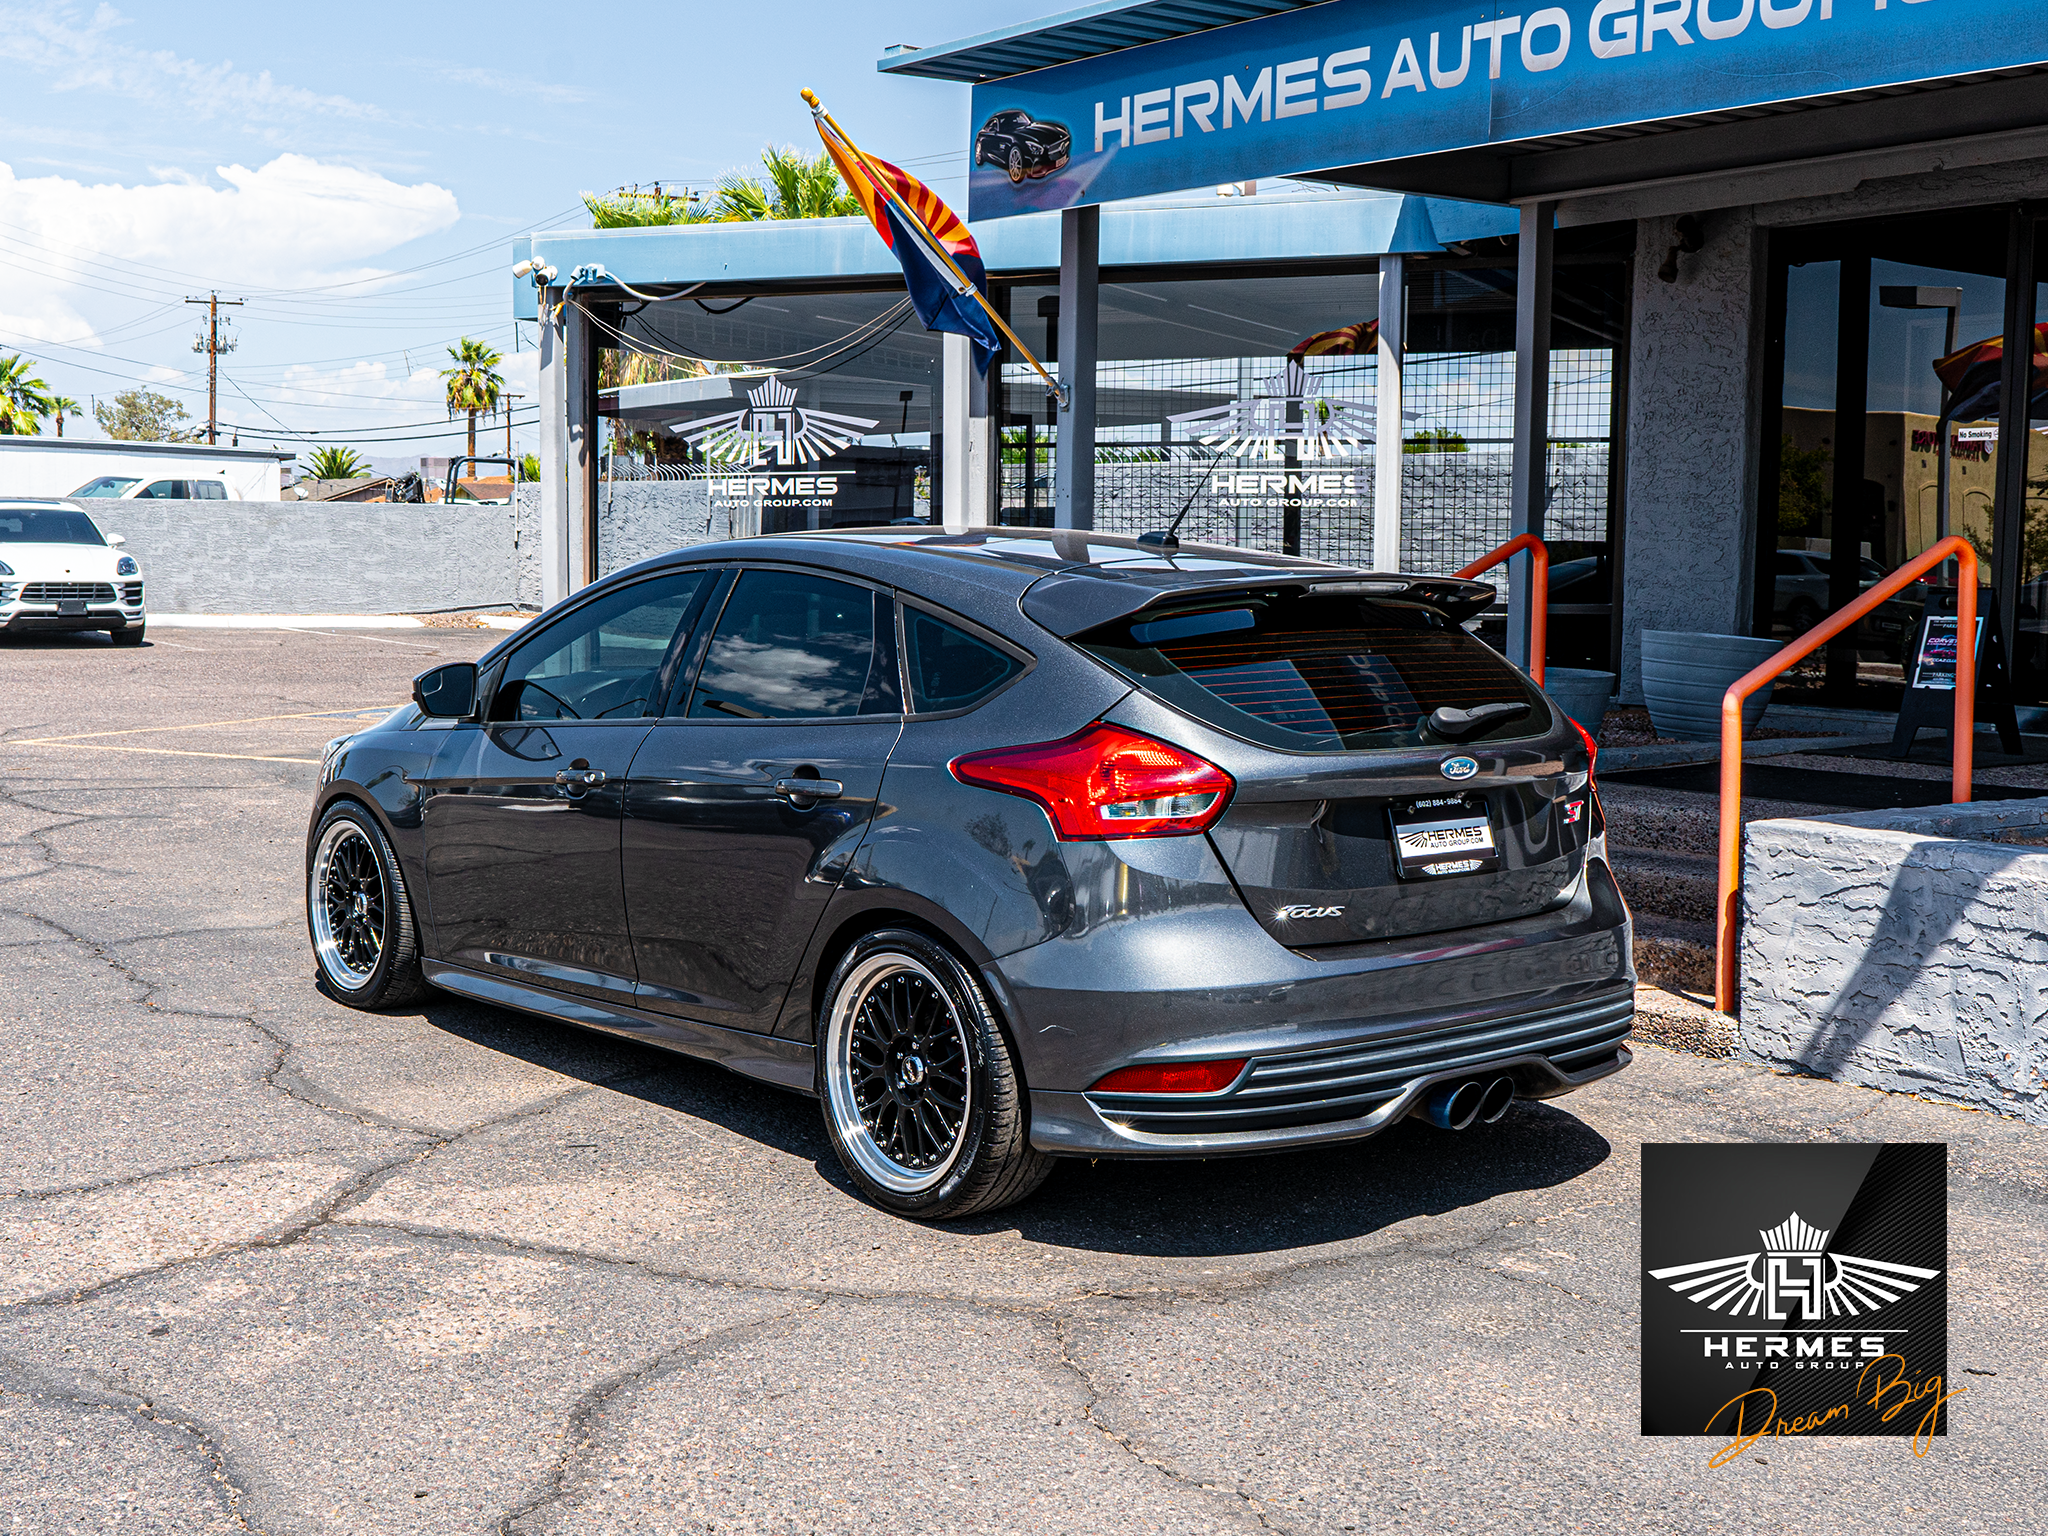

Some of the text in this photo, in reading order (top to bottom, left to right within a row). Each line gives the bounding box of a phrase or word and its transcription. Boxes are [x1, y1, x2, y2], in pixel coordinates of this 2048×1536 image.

[1094, 45, 1372, 153] HERMES
[1380, 6, 1571, 99] AUTO
[1968, 430, 1992, 439] Smoking
[708, 477, 838, 496] HERMES
[1211, 474, 1369, 494] HERMES
[714, 498, 833, 507] AUTO GROUP.COM
[1218, 498, 1262, 507] AUTO
[1449, 762, 1471, 775] Ford
[1563, 799, 1585, 824] ST
[1427, 825, 1482, 842] HERMES
[1430, 837, 1484, 848] AUTO GROUP.COM
[1435, 859, 1469, 871] HERMES
